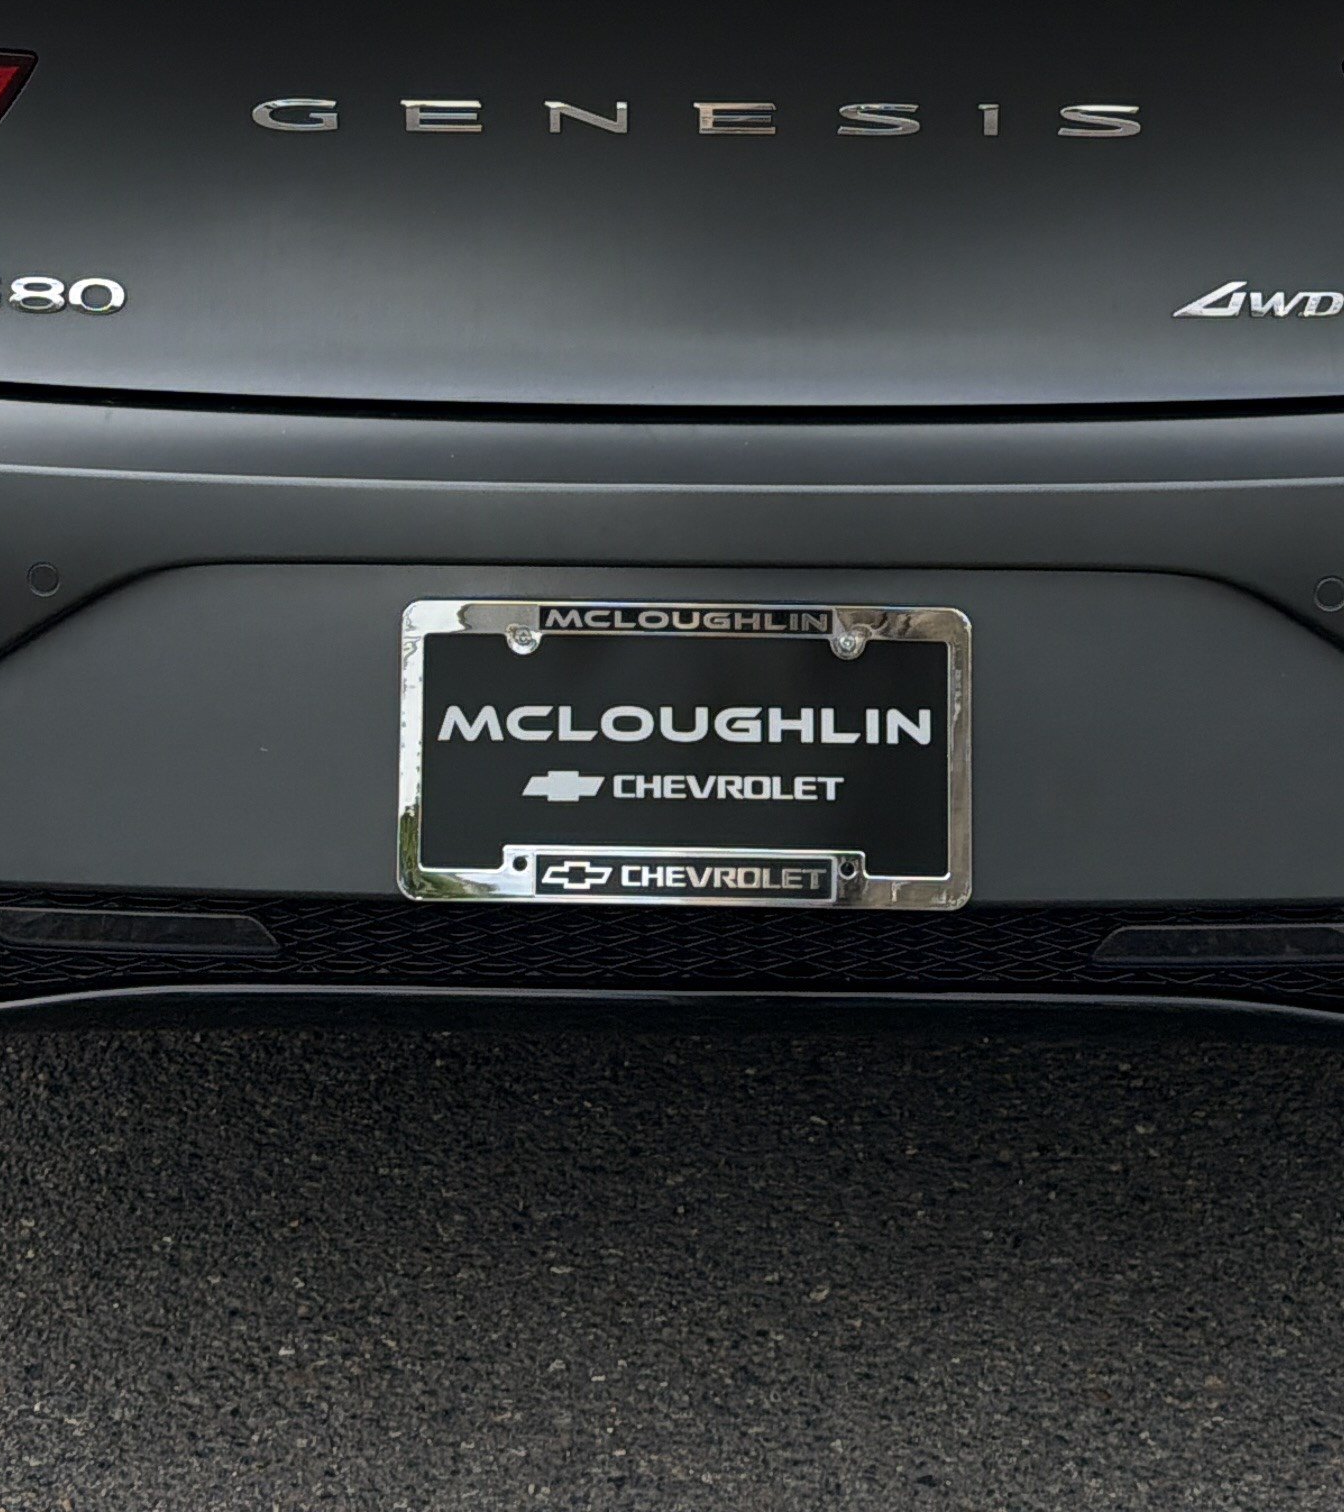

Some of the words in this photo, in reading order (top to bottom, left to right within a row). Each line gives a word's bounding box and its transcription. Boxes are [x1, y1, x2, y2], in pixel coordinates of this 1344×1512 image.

[251, 98, 1142, 137] GENESIS
[544, 608, 829, 632] MCLOUGHLIN
[437, 705, 932, 746] MCLOUGHLIN
[612, 774, 845, 801] CHEVROLET
[620, 865, 827, 890] CHEVROLET
